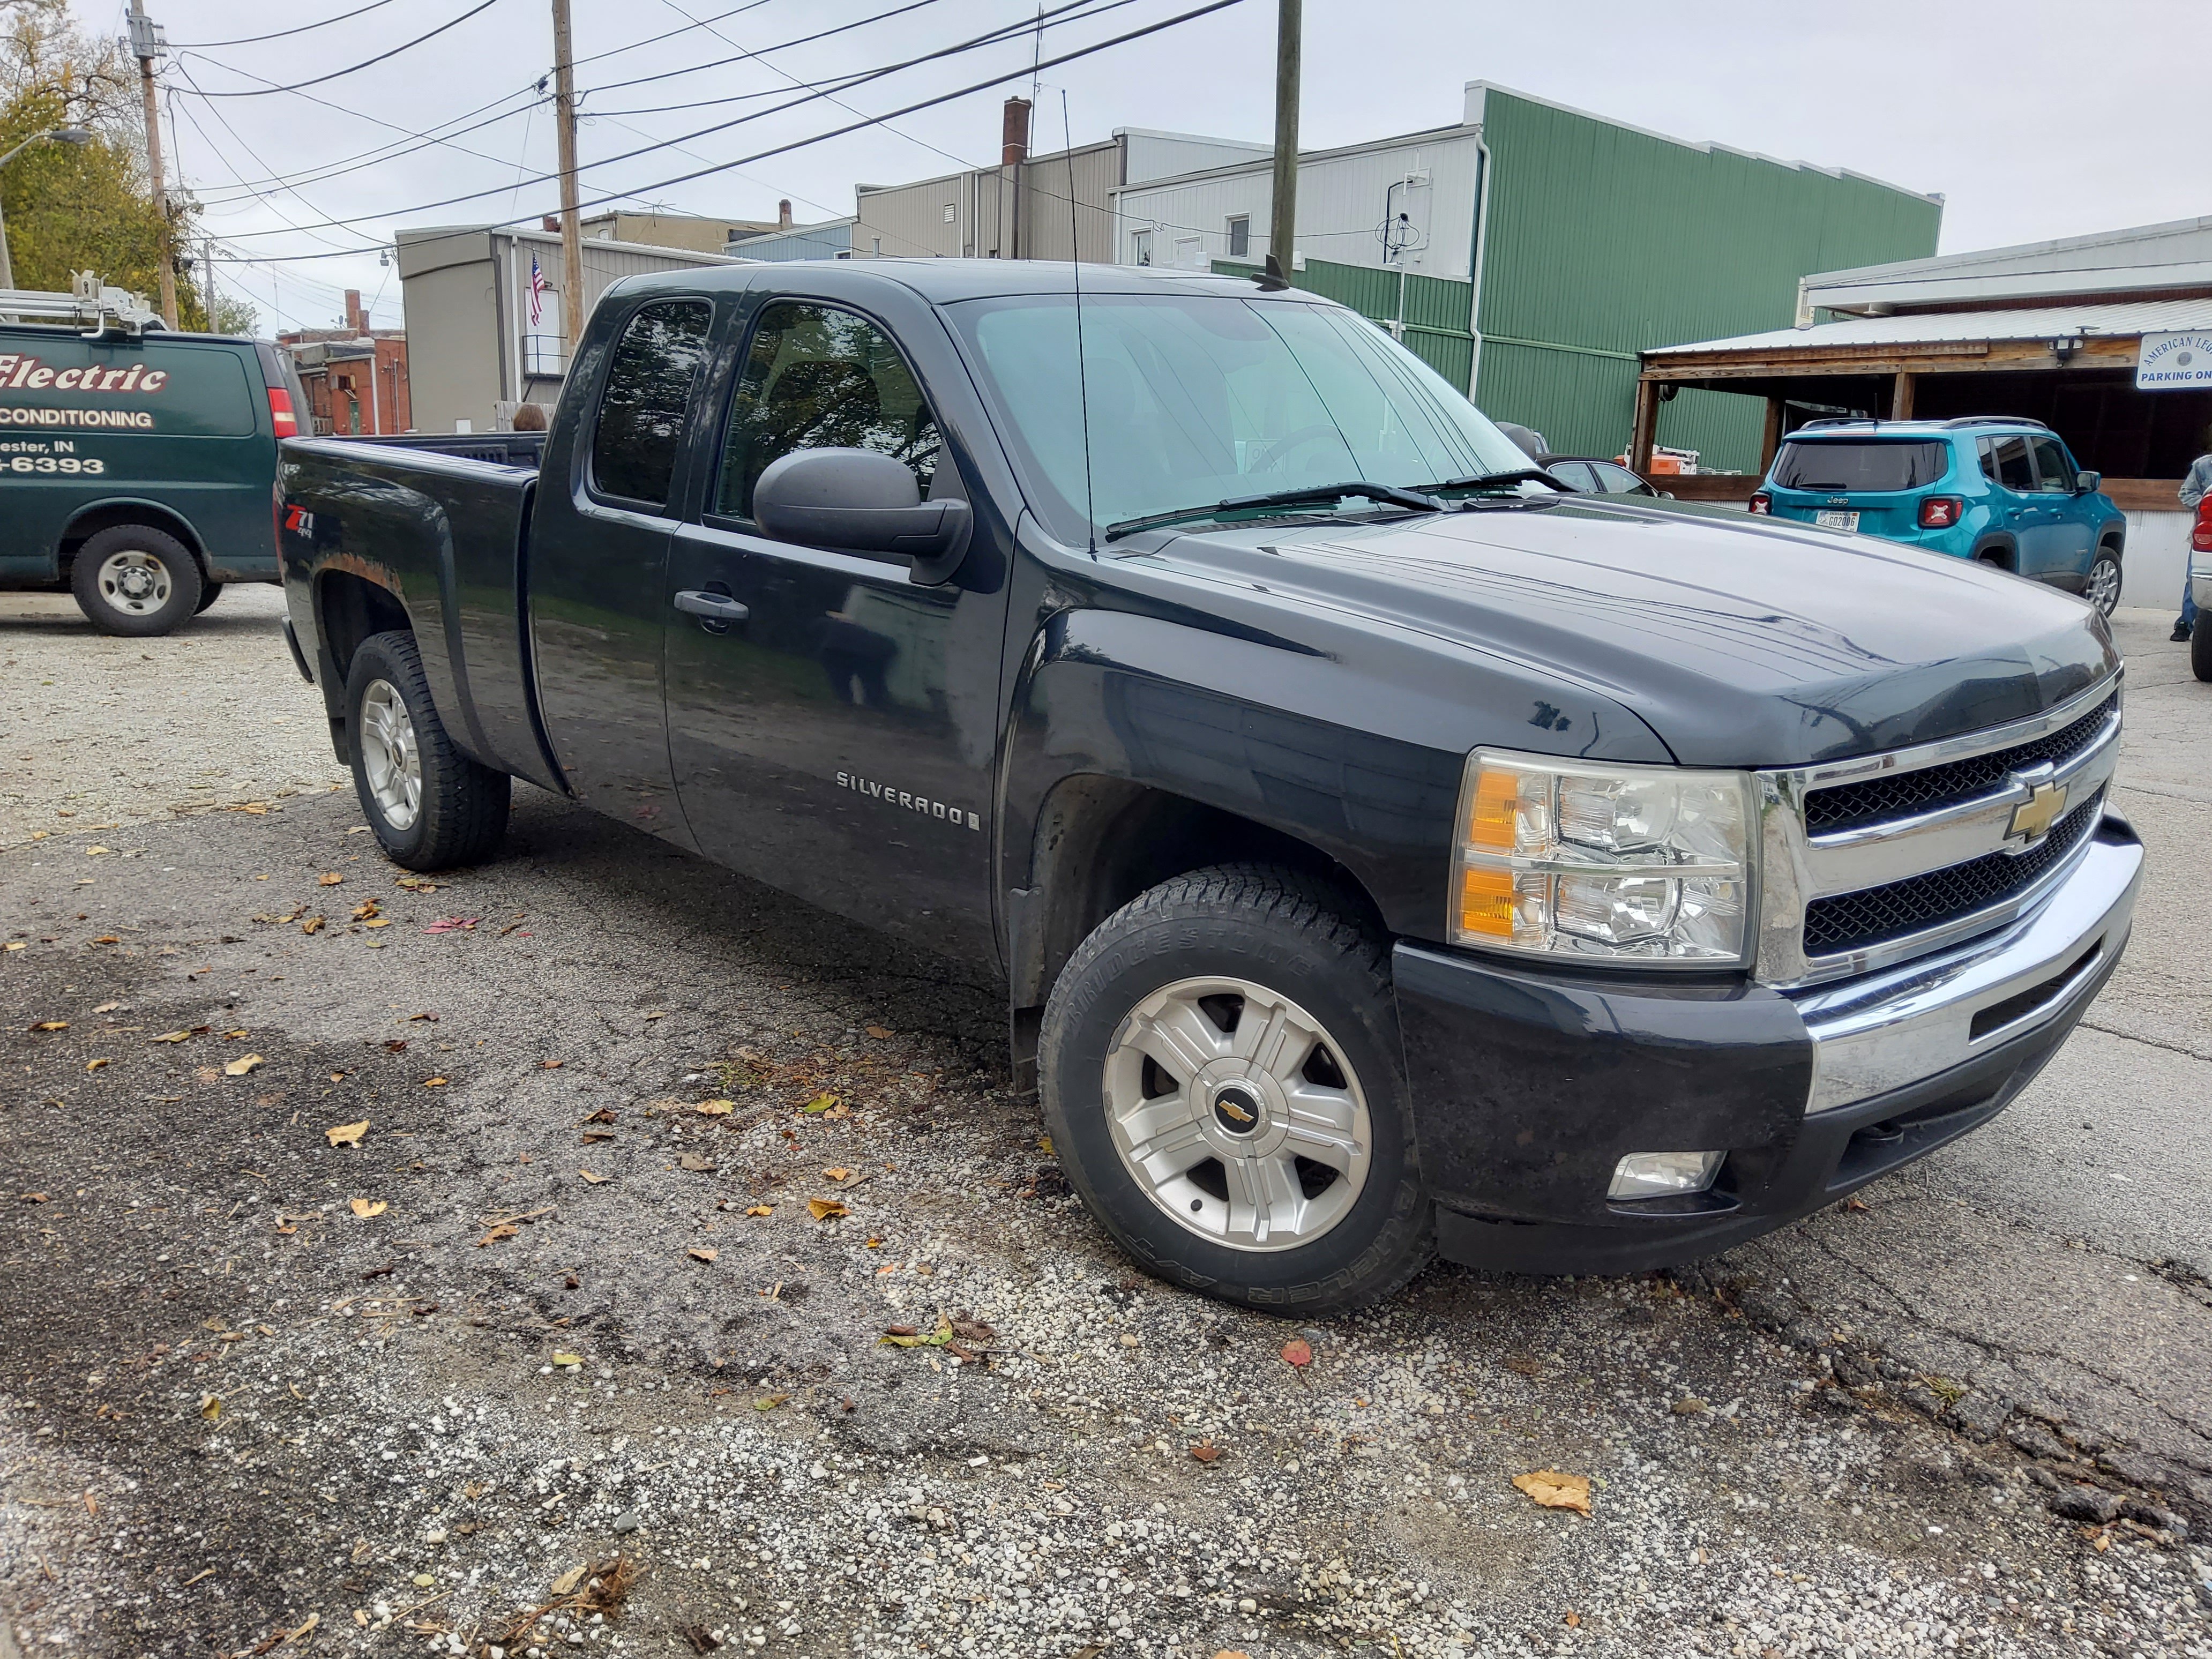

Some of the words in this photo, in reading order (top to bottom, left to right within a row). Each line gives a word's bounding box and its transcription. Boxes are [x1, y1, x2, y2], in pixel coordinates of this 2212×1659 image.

[2143, 337, 2193, 367] AMERICAN
[2195, 337, 2212, 355] LEG
[0, 354, 167, 391] Electric
[2141, 371, 2192, 382] PARKING
[2196, 370, 2212, 379] ON
[0, 408, 152, 428] CONDITIONING
[54, 440, 74, 452] IN
[0, 457, 104, 474] -6393
[1827, 496, 1849, 505] Jeep
[285, 504, 314, 531] Z71
[836, 771, 962, 825] SILVERADO
